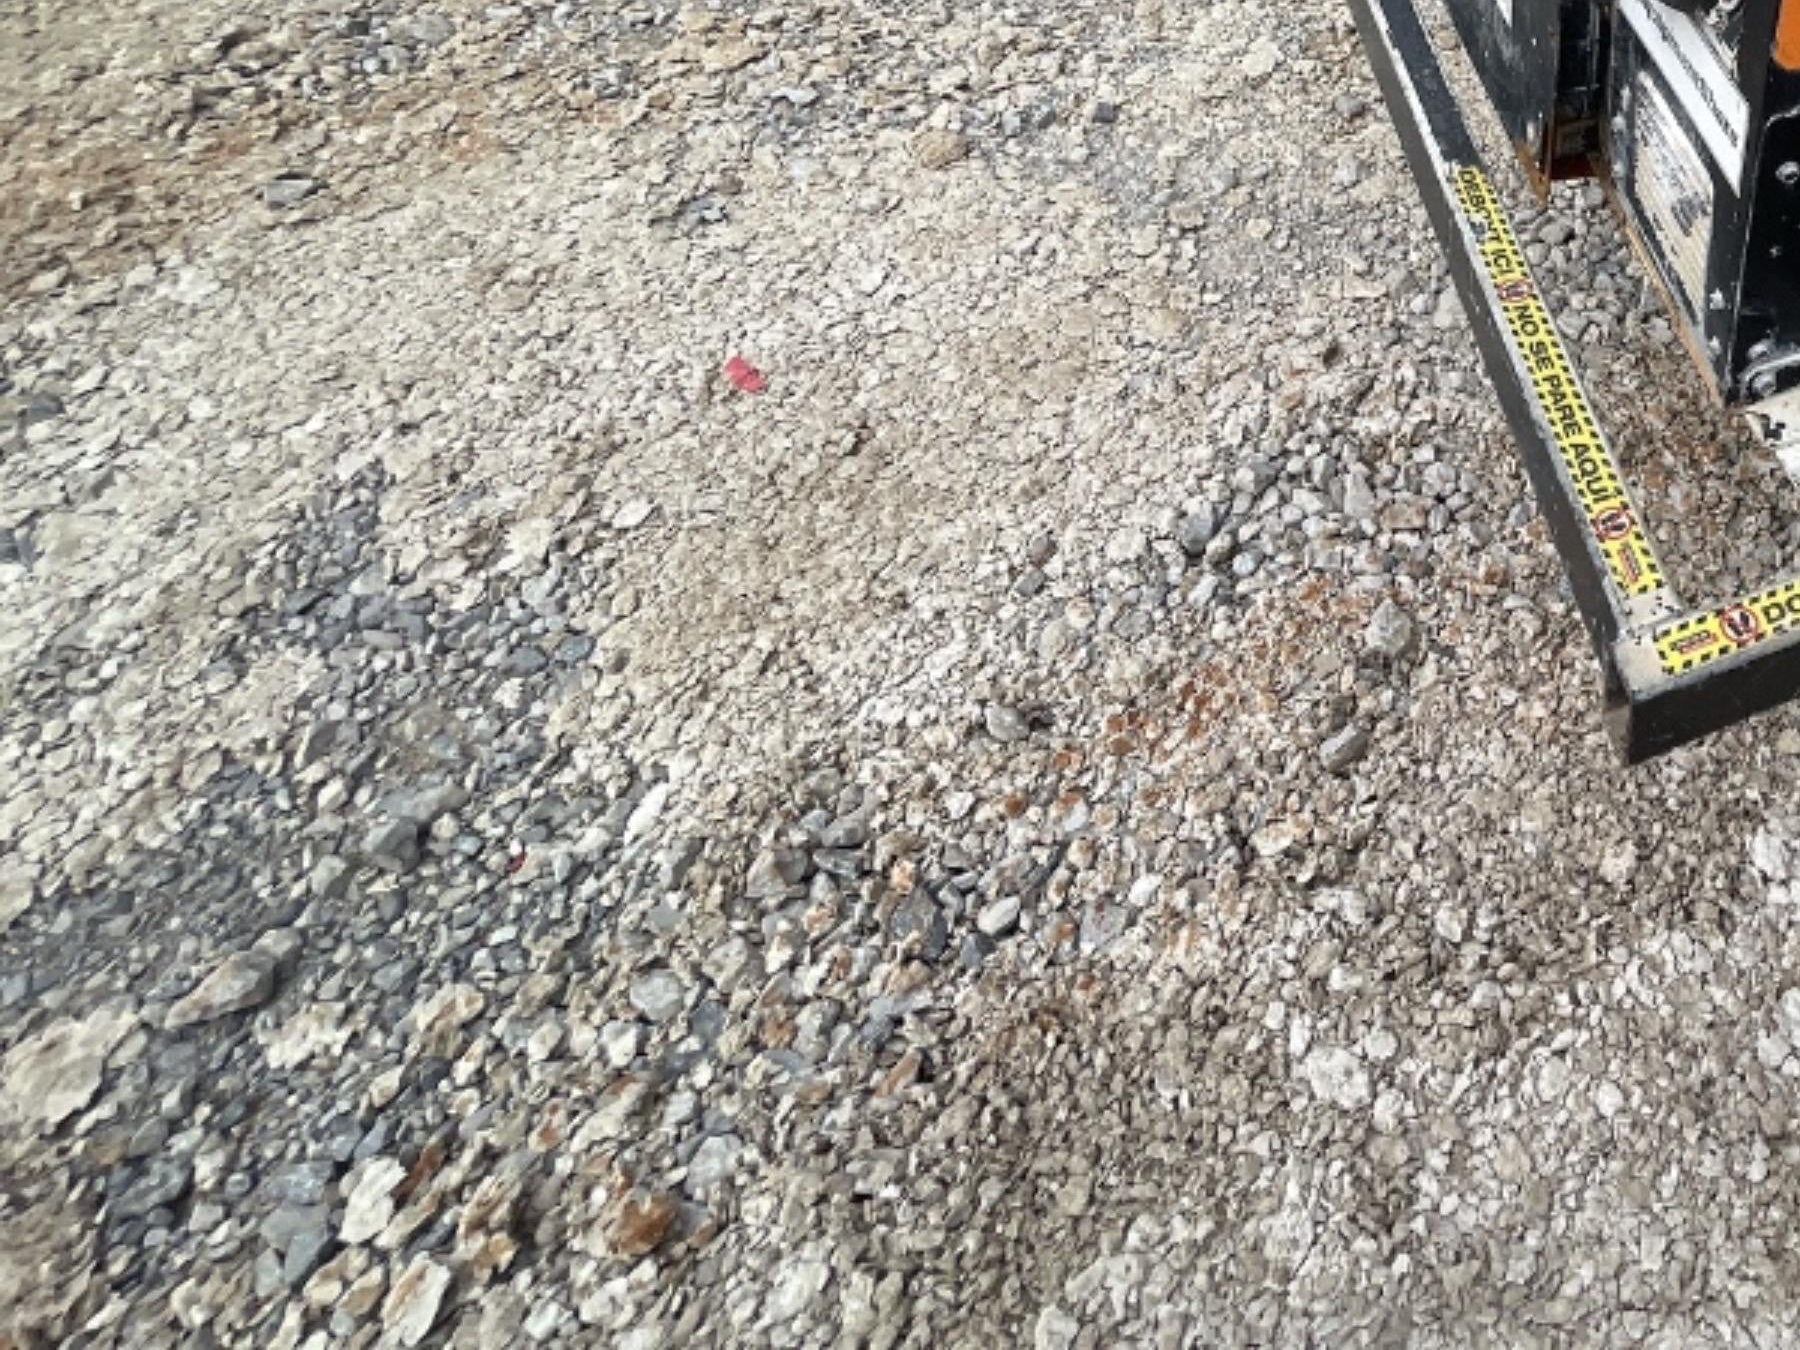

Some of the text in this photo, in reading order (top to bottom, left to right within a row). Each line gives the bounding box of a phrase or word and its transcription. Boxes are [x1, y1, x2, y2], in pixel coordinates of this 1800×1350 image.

[1490, 248, 1516, 276] ICI
[1513, 304, 1540, 337] NO
[1529, 340, 1555, 372] SE
[1542, 373, 1583, 438] PARE
